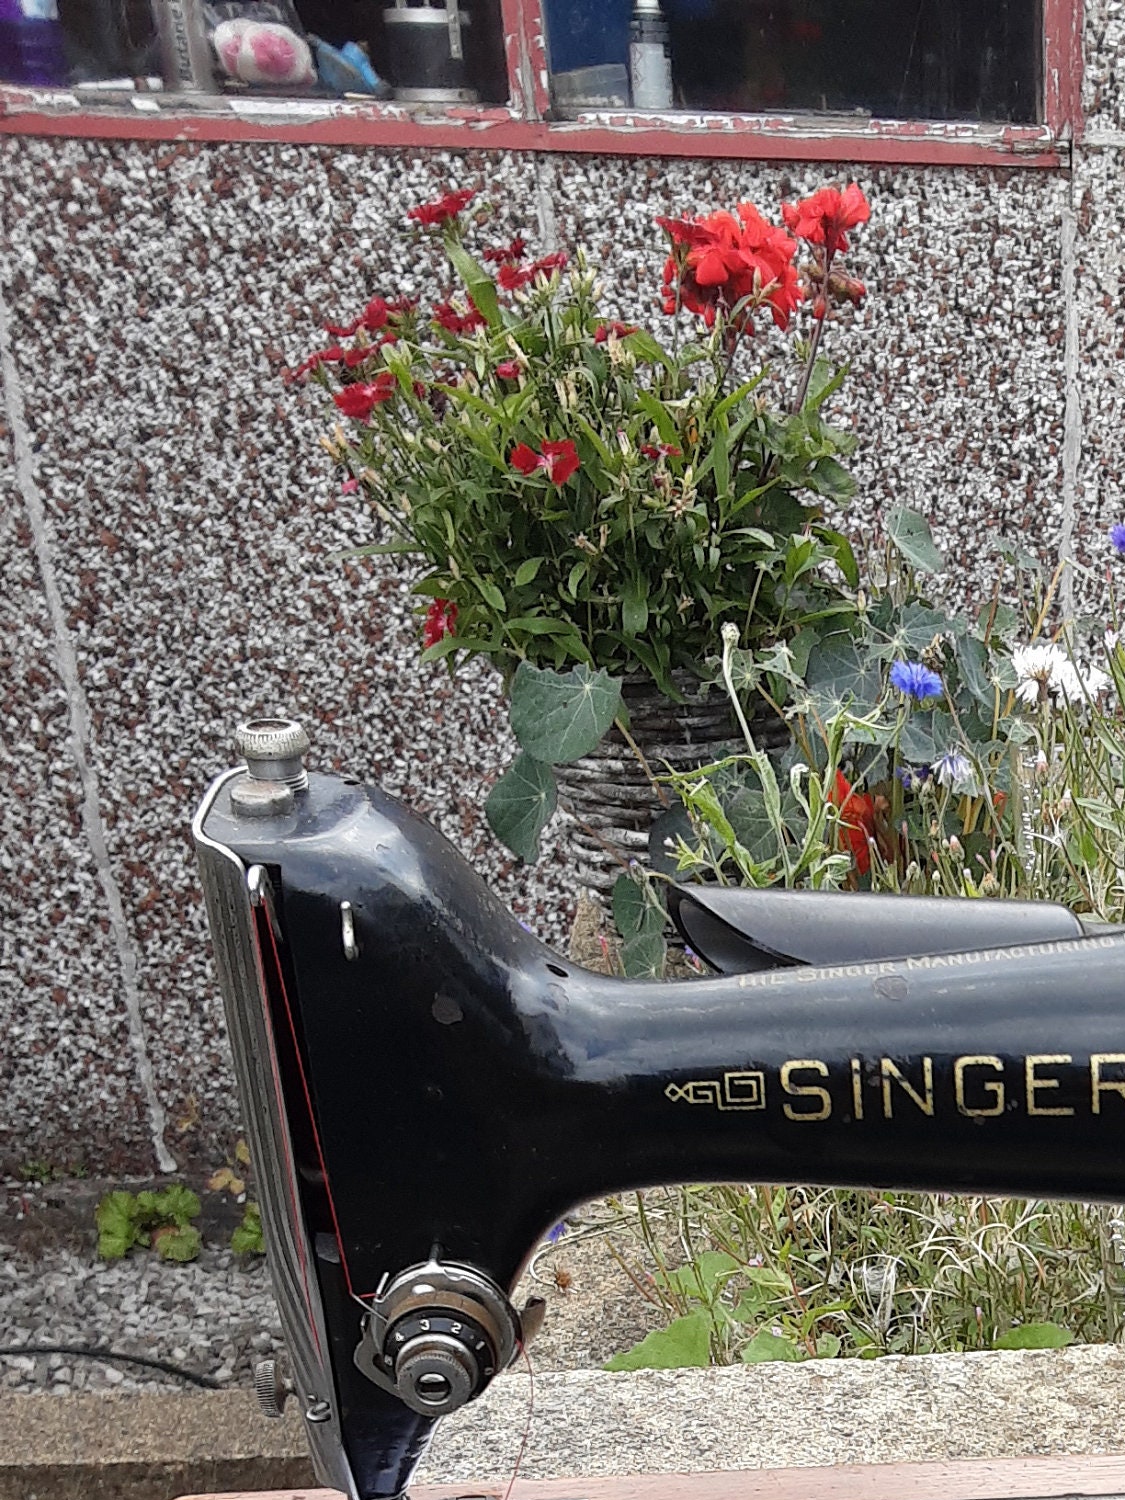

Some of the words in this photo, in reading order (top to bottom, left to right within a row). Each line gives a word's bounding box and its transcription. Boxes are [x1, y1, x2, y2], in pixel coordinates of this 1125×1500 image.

[797, 962, 897, 983] SINGER
[420, 1319, 430, 1331] 3
[451, 1321, 462, 1334] 2
